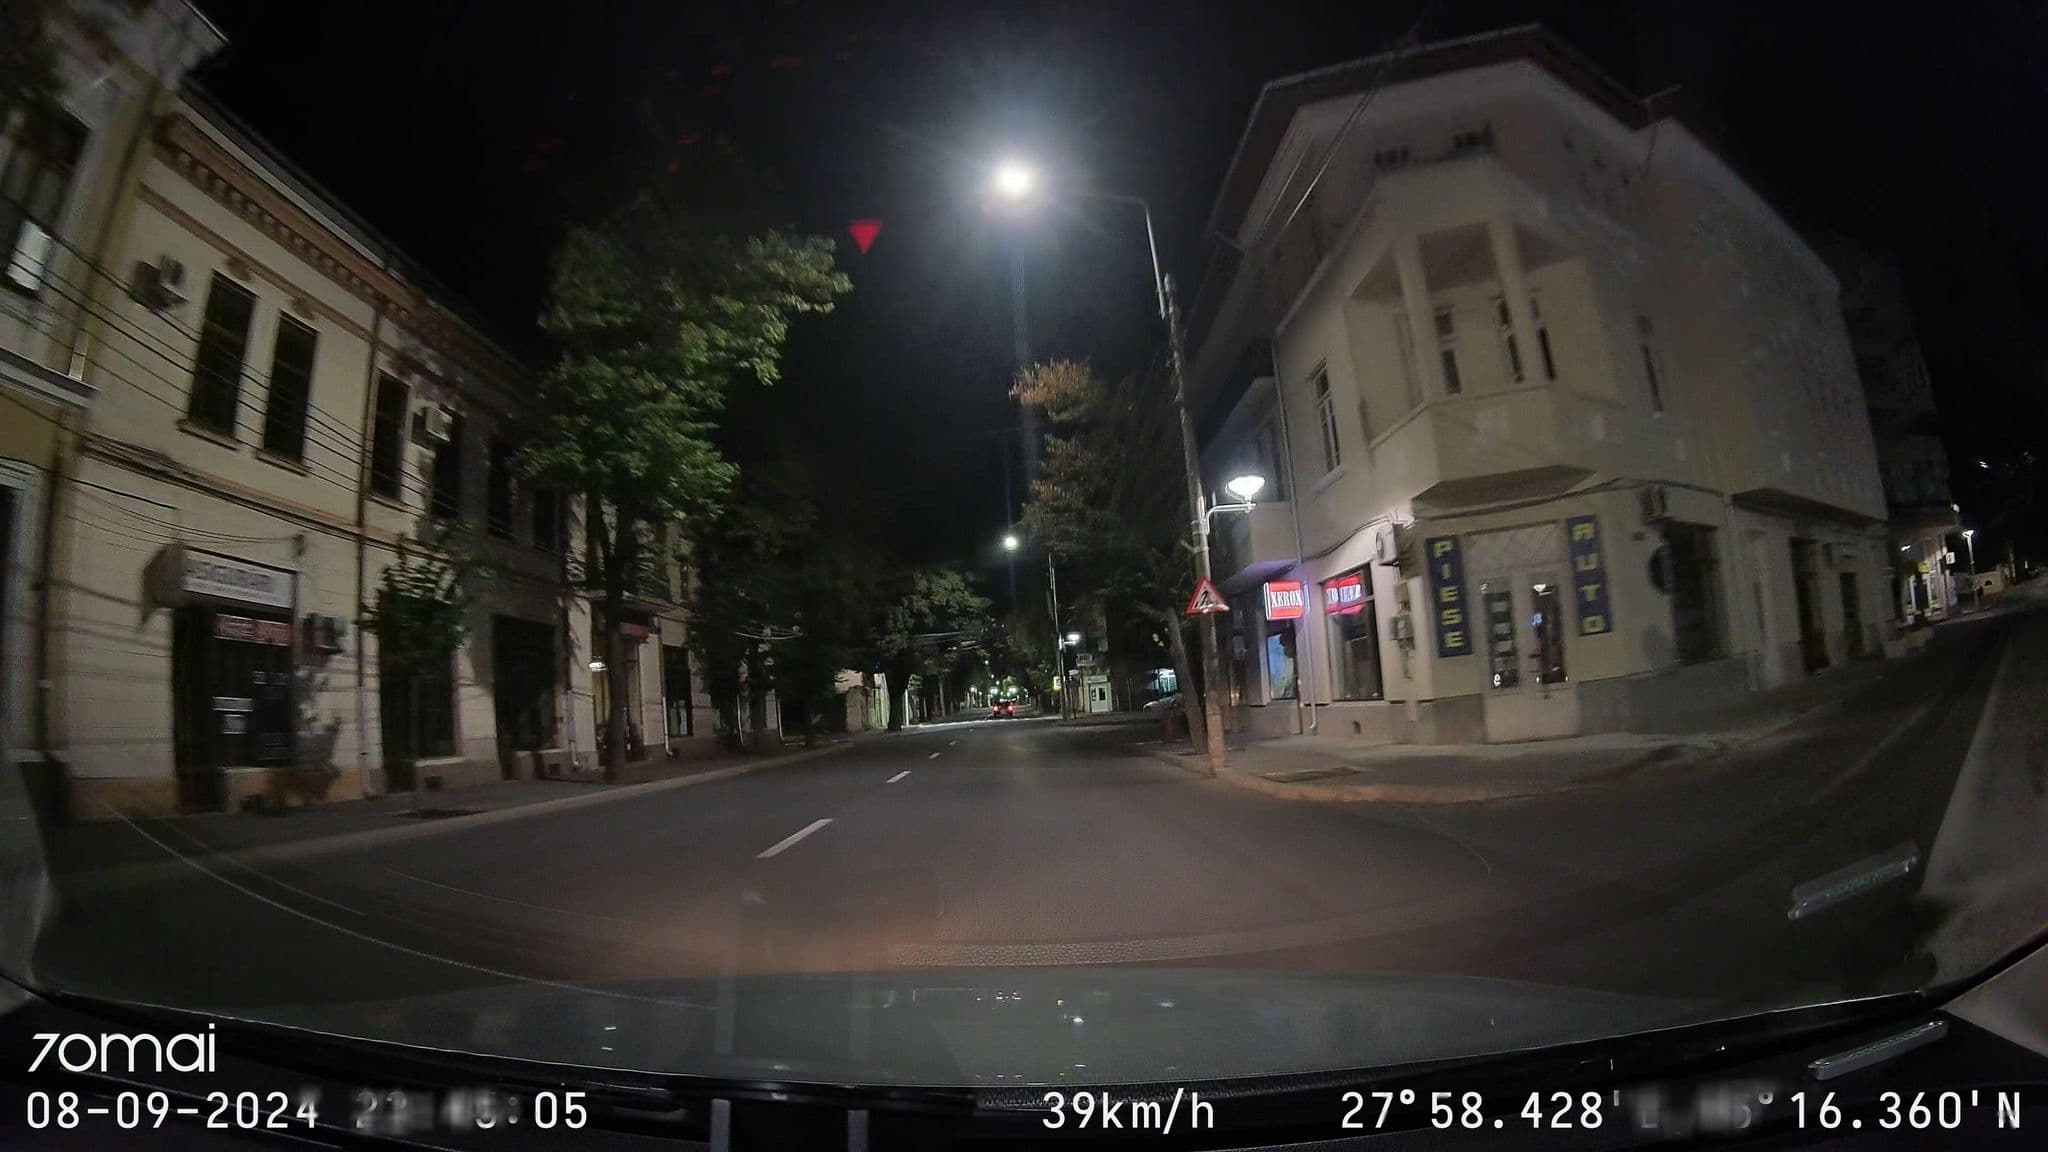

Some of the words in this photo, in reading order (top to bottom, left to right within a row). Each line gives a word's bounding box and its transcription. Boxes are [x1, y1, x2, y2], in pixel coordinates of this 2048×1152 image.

[1270, 589, 1303, 608] XEROX
[1432, 540, 1466, 648] PIESE
[1571, 523, 1607, 633] AUTO
